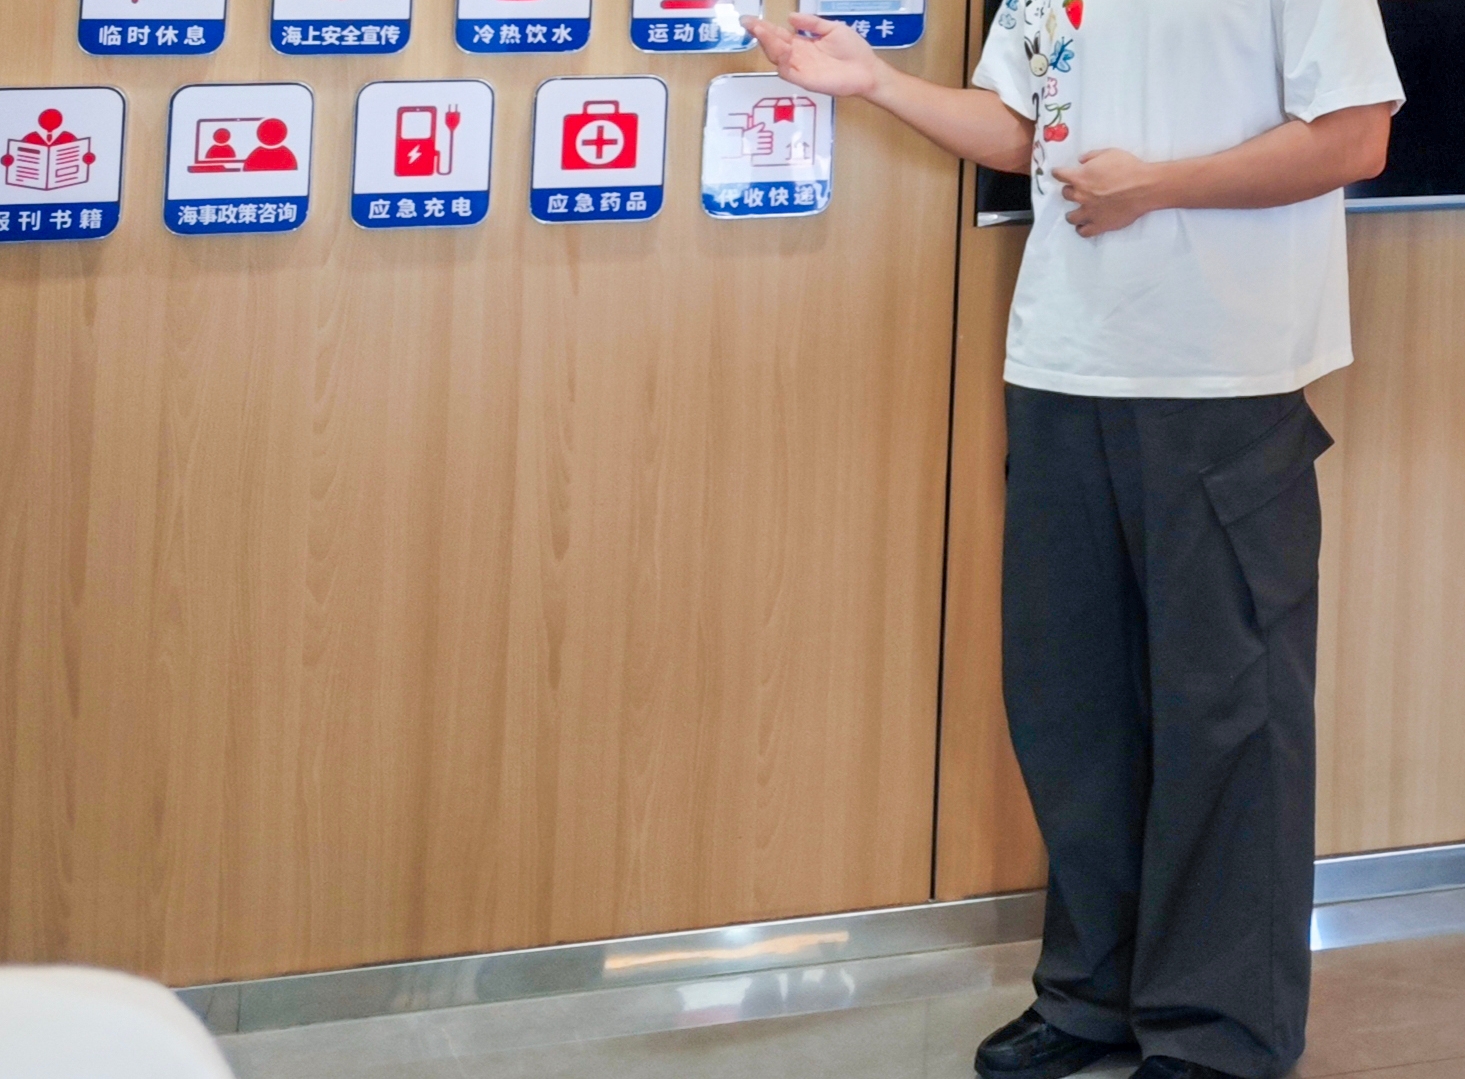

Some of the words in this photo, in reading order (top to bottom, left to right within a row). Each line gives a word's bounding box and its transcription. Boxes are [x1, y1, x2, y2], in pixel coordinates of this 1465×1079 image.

[99, 25, 206, 47] 临时休息
[281, 25, 401, 46] 海上安全宣传
[473, 23, 573, 45] 冷热饮水
[647, 23, 745, 43] 运动健
[547, 192, 647, 214] 应急药品
[719, 185, 816, 209] 代收快递
[177, 202, 298, 226] 海事政策咨询
[368, 197, 473, 220] 应急充电
